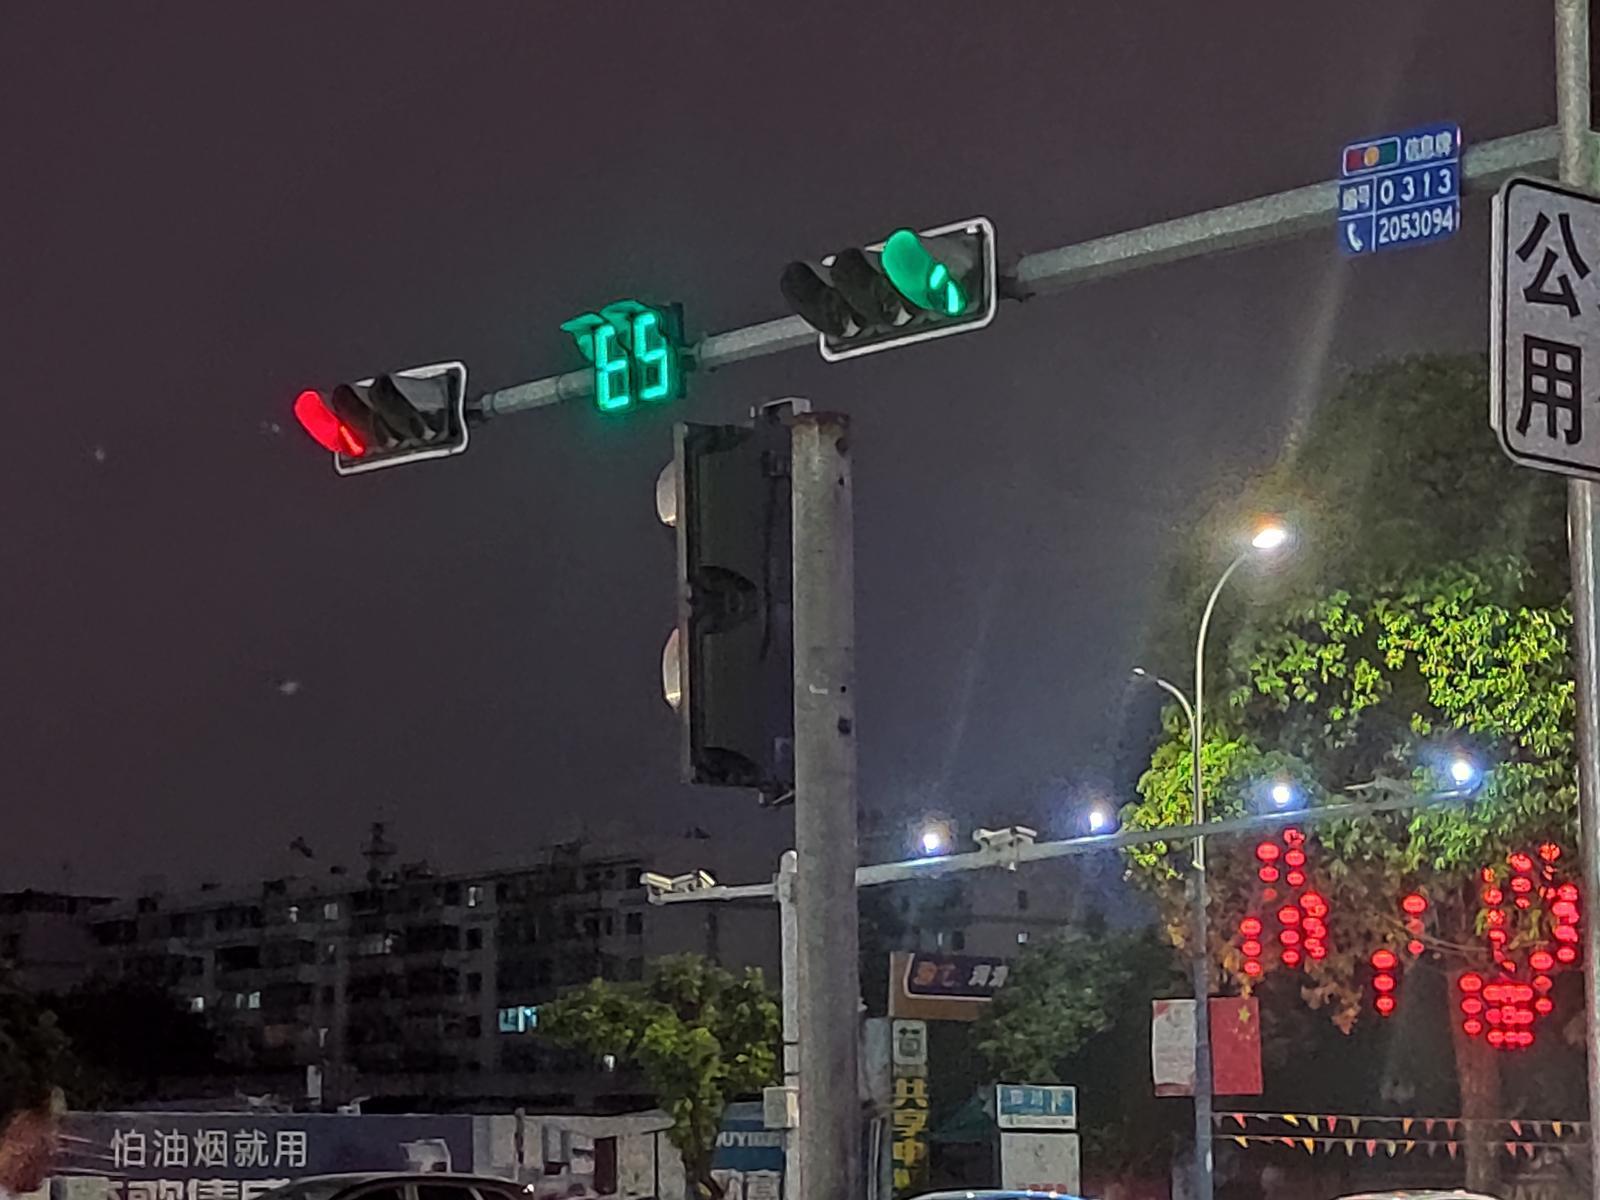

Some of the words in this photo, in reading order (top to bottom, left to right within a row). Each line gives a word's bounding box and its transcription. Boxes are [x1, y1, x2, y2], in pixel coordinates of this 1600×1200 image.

[1379, 168, 1452, 206] 0313
[1379, 205, 1453, 244] 2053094
[1515, 211, 1591, 445] 公用
[110, 1128, 308, 1169] 怕油烟就用
